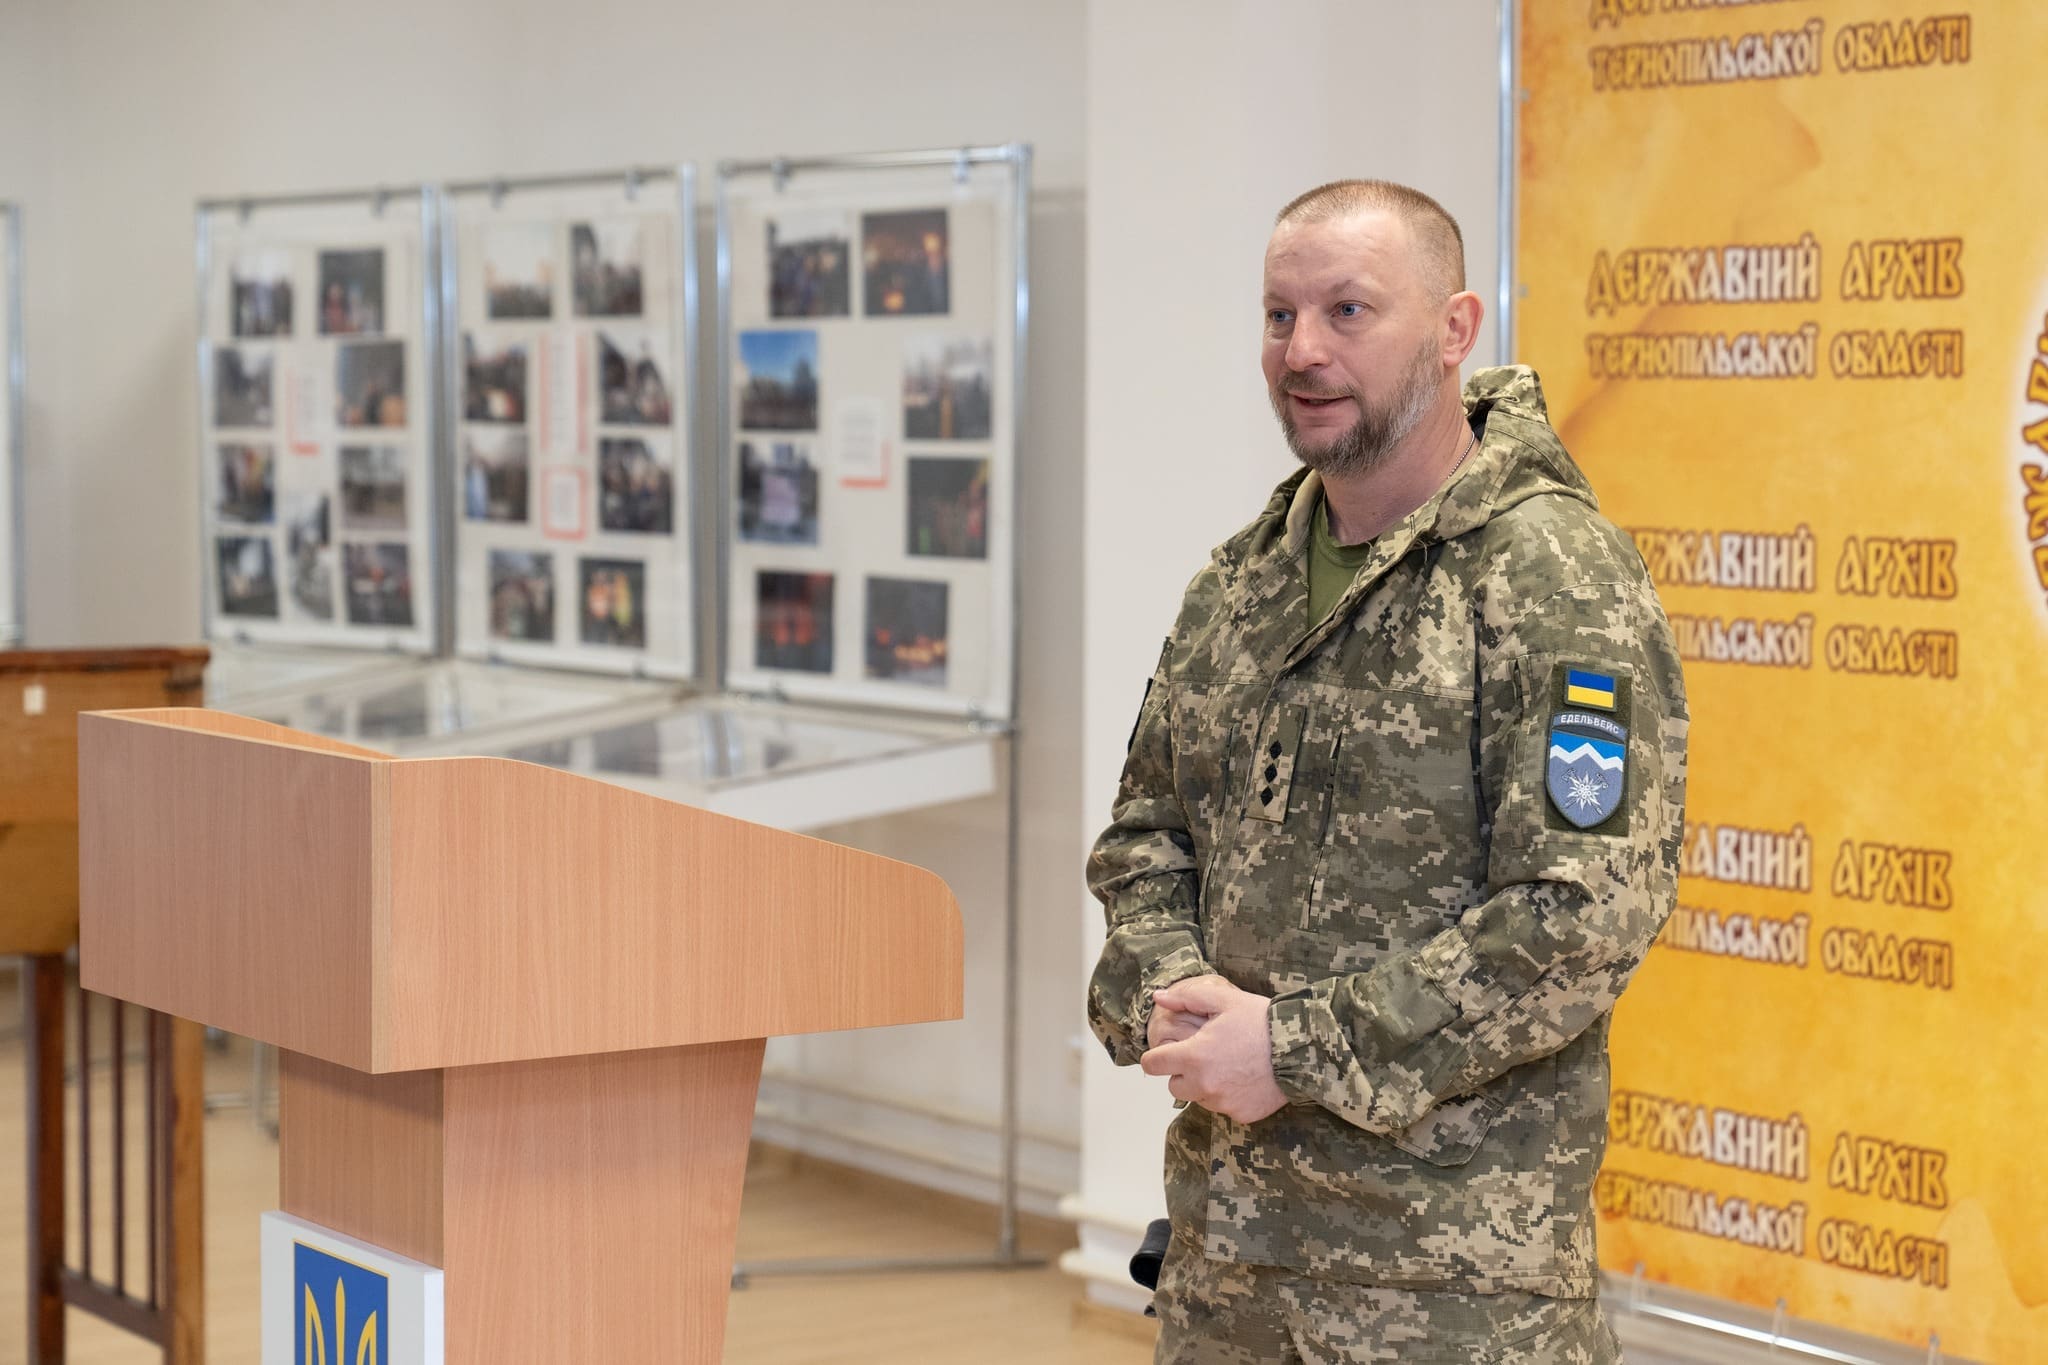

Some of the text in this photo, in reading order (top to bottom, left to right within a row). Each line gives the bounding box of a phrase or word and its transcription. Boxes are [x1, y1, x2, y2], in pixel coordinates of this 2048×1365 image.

[1835, 13, 1971, 72] ОБЛАСТІ
[1841, 237, 1963, 300] АРХІВ
[1830, 330, 1964, 380] ОБЛАСТІ
[1837, 536, 1957, 600] АРХІВ
[1826, 623, 1958, 680] ОБЛАСТІ
[1560, 714, 1620, 735] ЕДЕЛЬВЕЙС
[1833, 840, 1952, 911] АРХІВ
[1821, 927, 1953, 990] ОБЛАСТІ
[1609, 1089, 1948, 1209] ЕРЖАВНИЙ АРХІВ
[1595, 1171, 1949, 1290] ЕРНОПІЛЬСЬКОЇ ОБЛАСТІ
